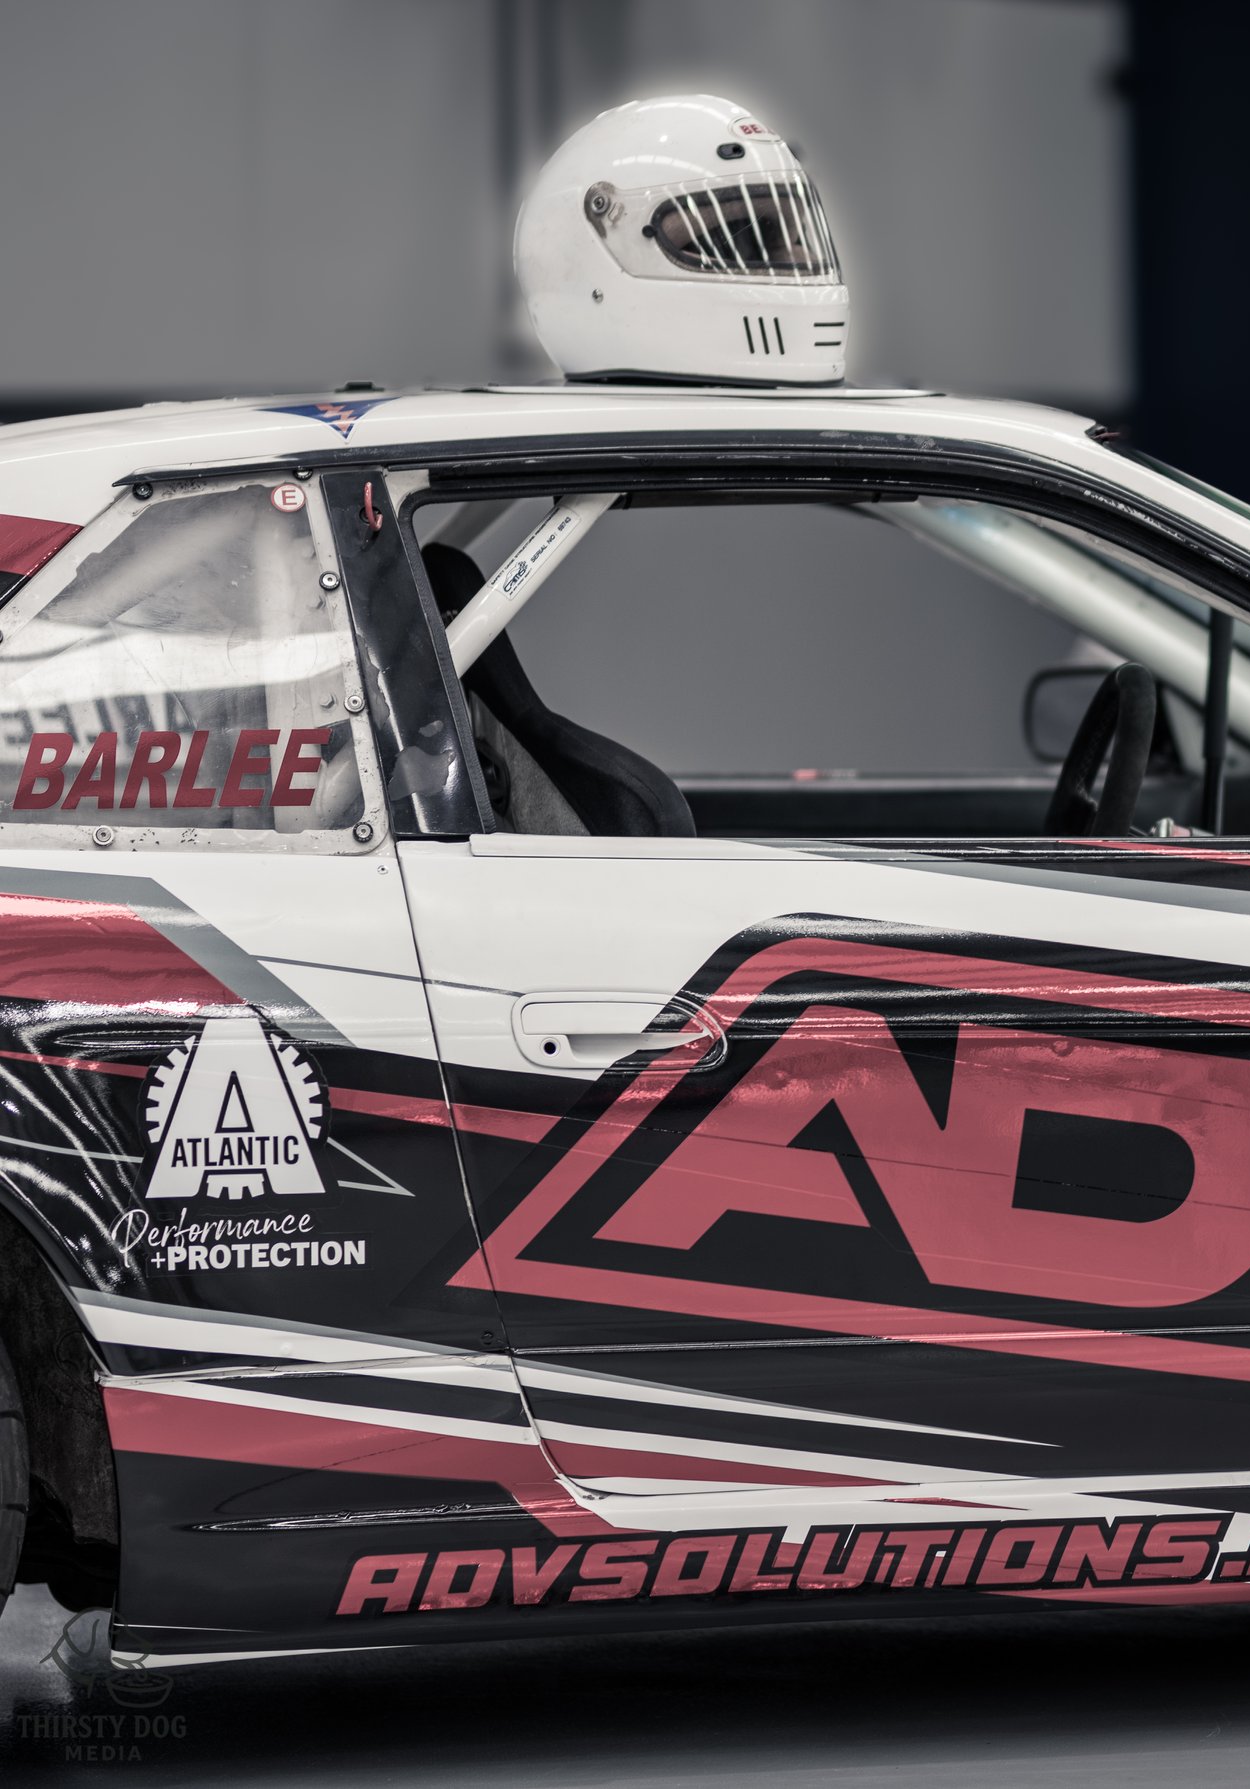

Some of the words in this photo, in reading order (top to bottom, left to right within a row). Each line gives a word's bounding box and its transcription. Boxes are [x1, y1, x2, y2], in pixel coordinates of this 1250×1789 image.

[281, 489, 297, 506] E
[12, 728, 332, 811] BARLEE
[171, 1135, 299, 1168] ATLANTIC
[110, 1207, 314, 1267] Performance
